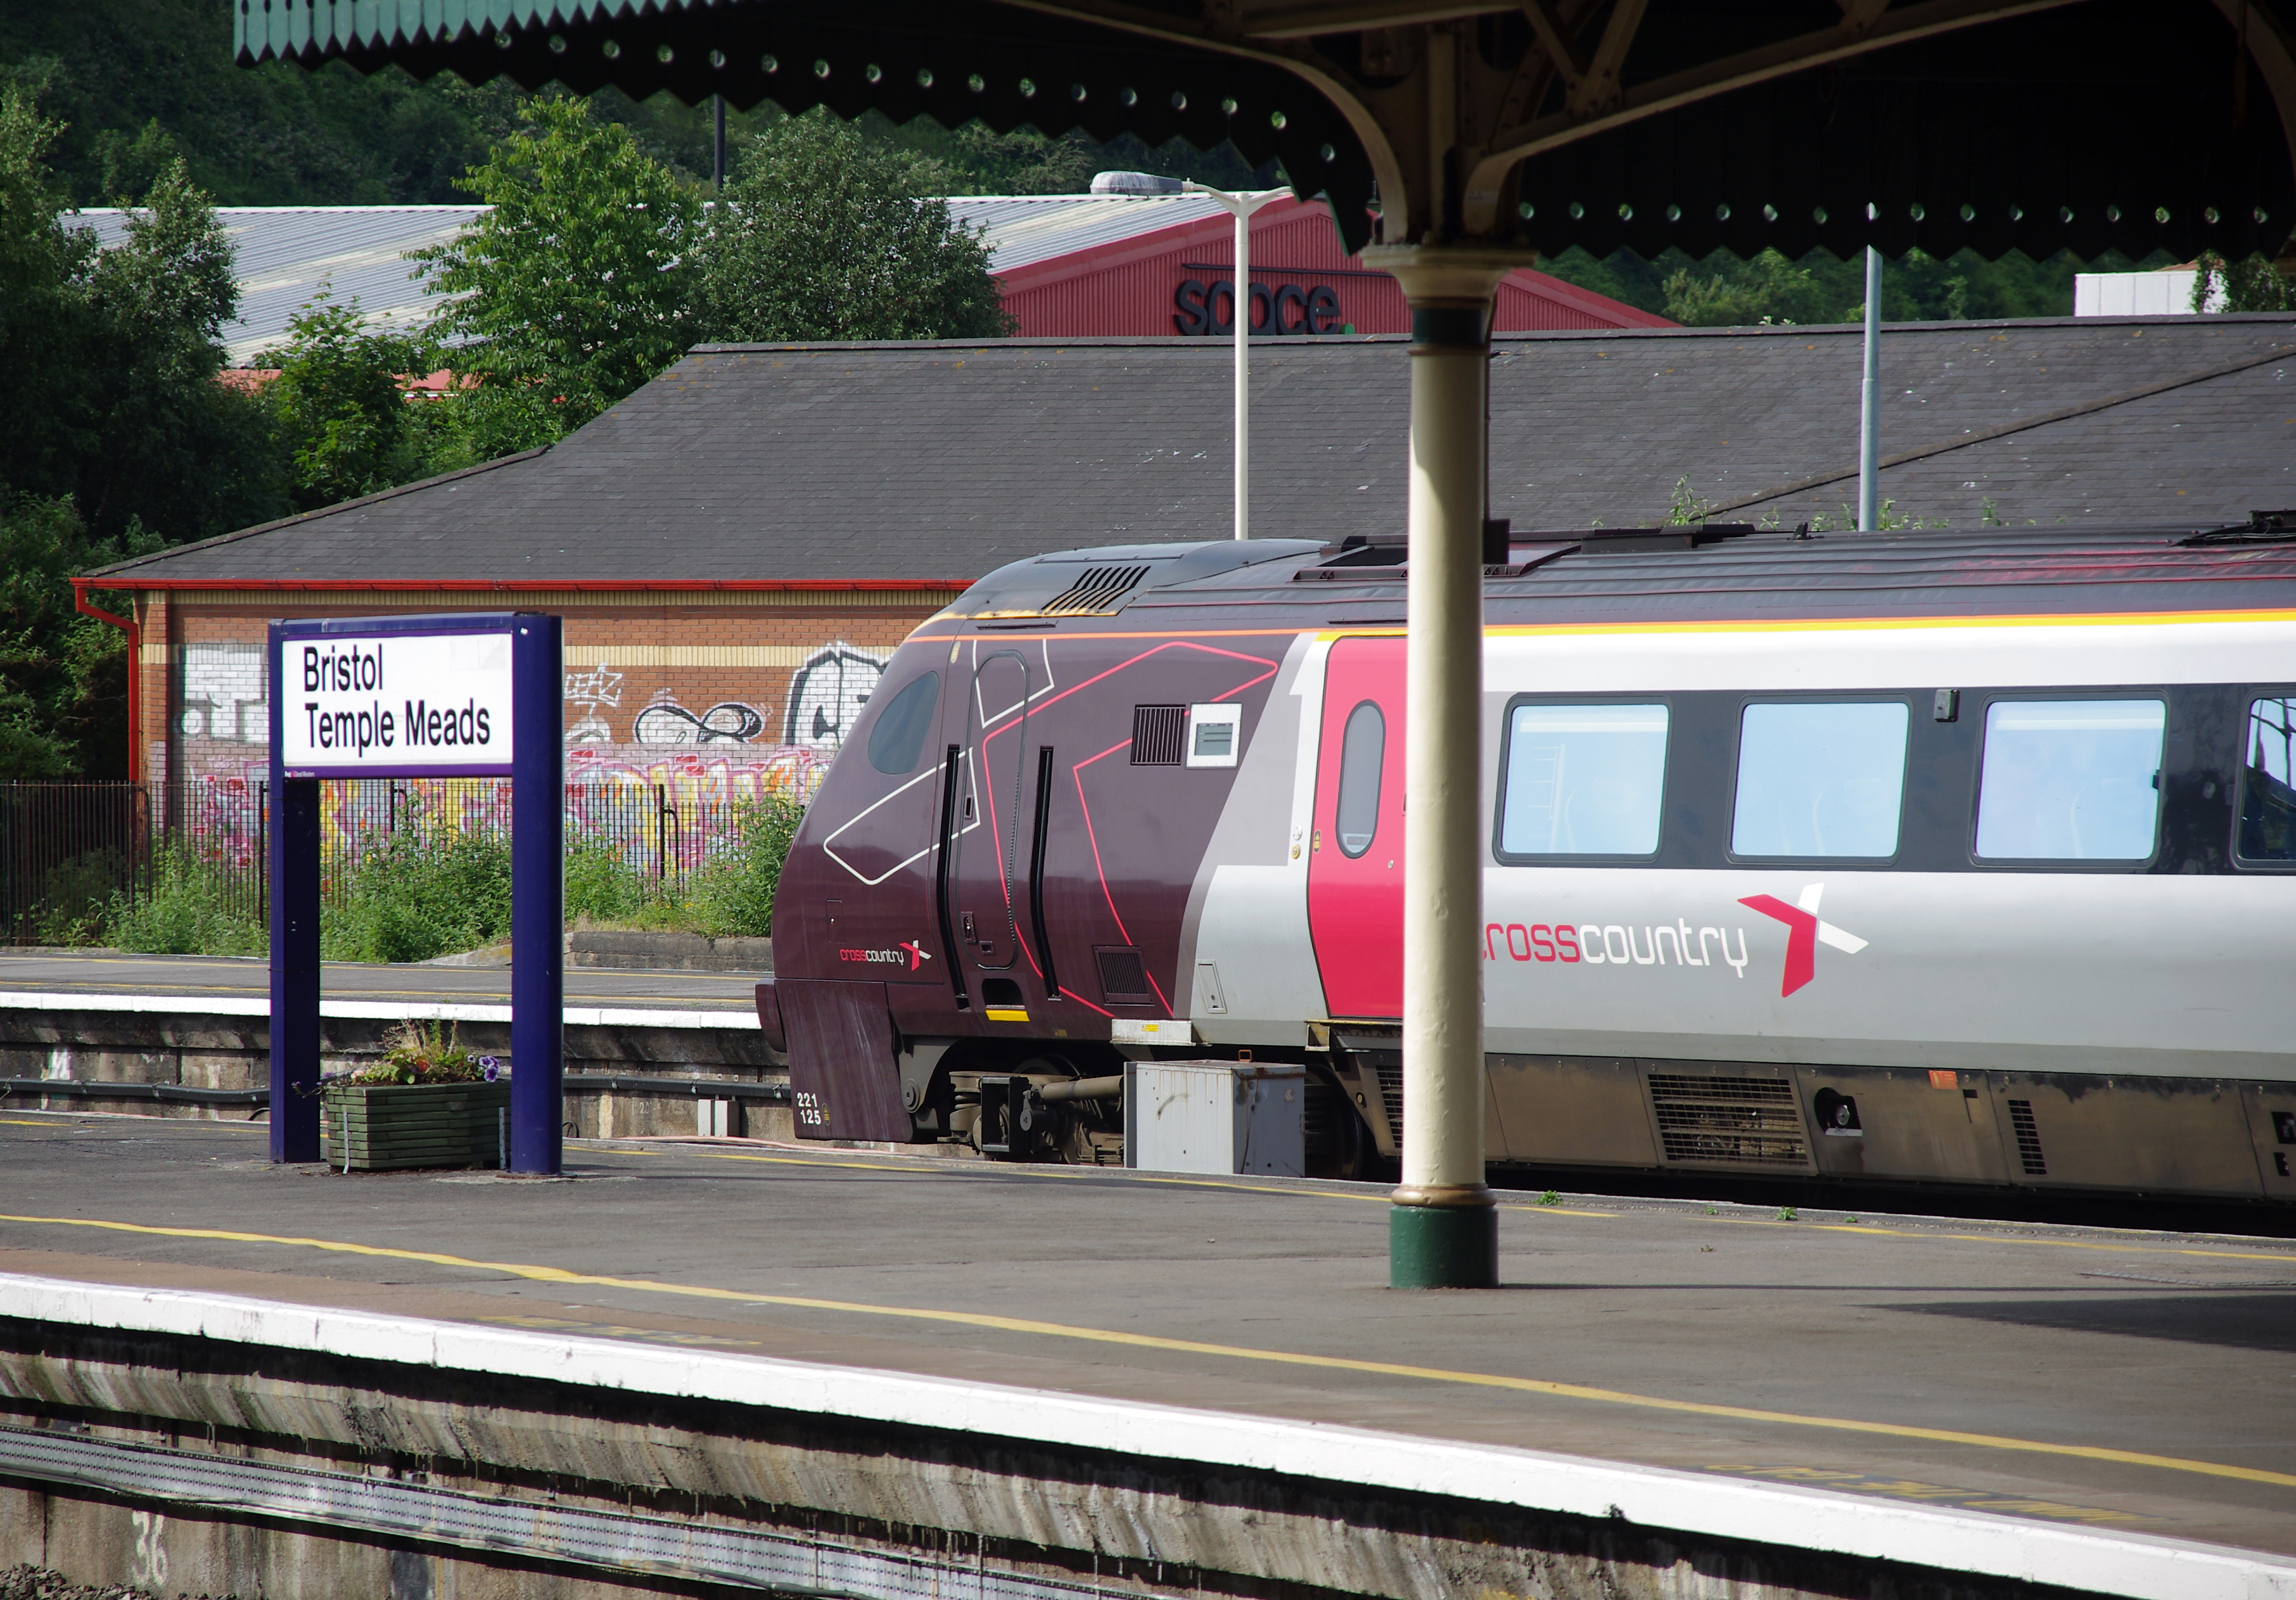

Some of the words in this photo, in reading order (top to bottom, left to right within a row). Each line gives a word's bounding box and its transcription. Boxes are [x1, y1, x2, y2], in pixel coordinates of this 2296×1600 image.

[303, 643, 383, 692] Bristol
[305, 699, 394, 758] Temple
[405, 697, 490, 746] Meads
[839, 948, 905, 966] crosscountry
[1482, 917, 1749, 978] rosscountry
[797, 1092, 818, 1108] 221
[800, 1109, 822, 1125] 125
